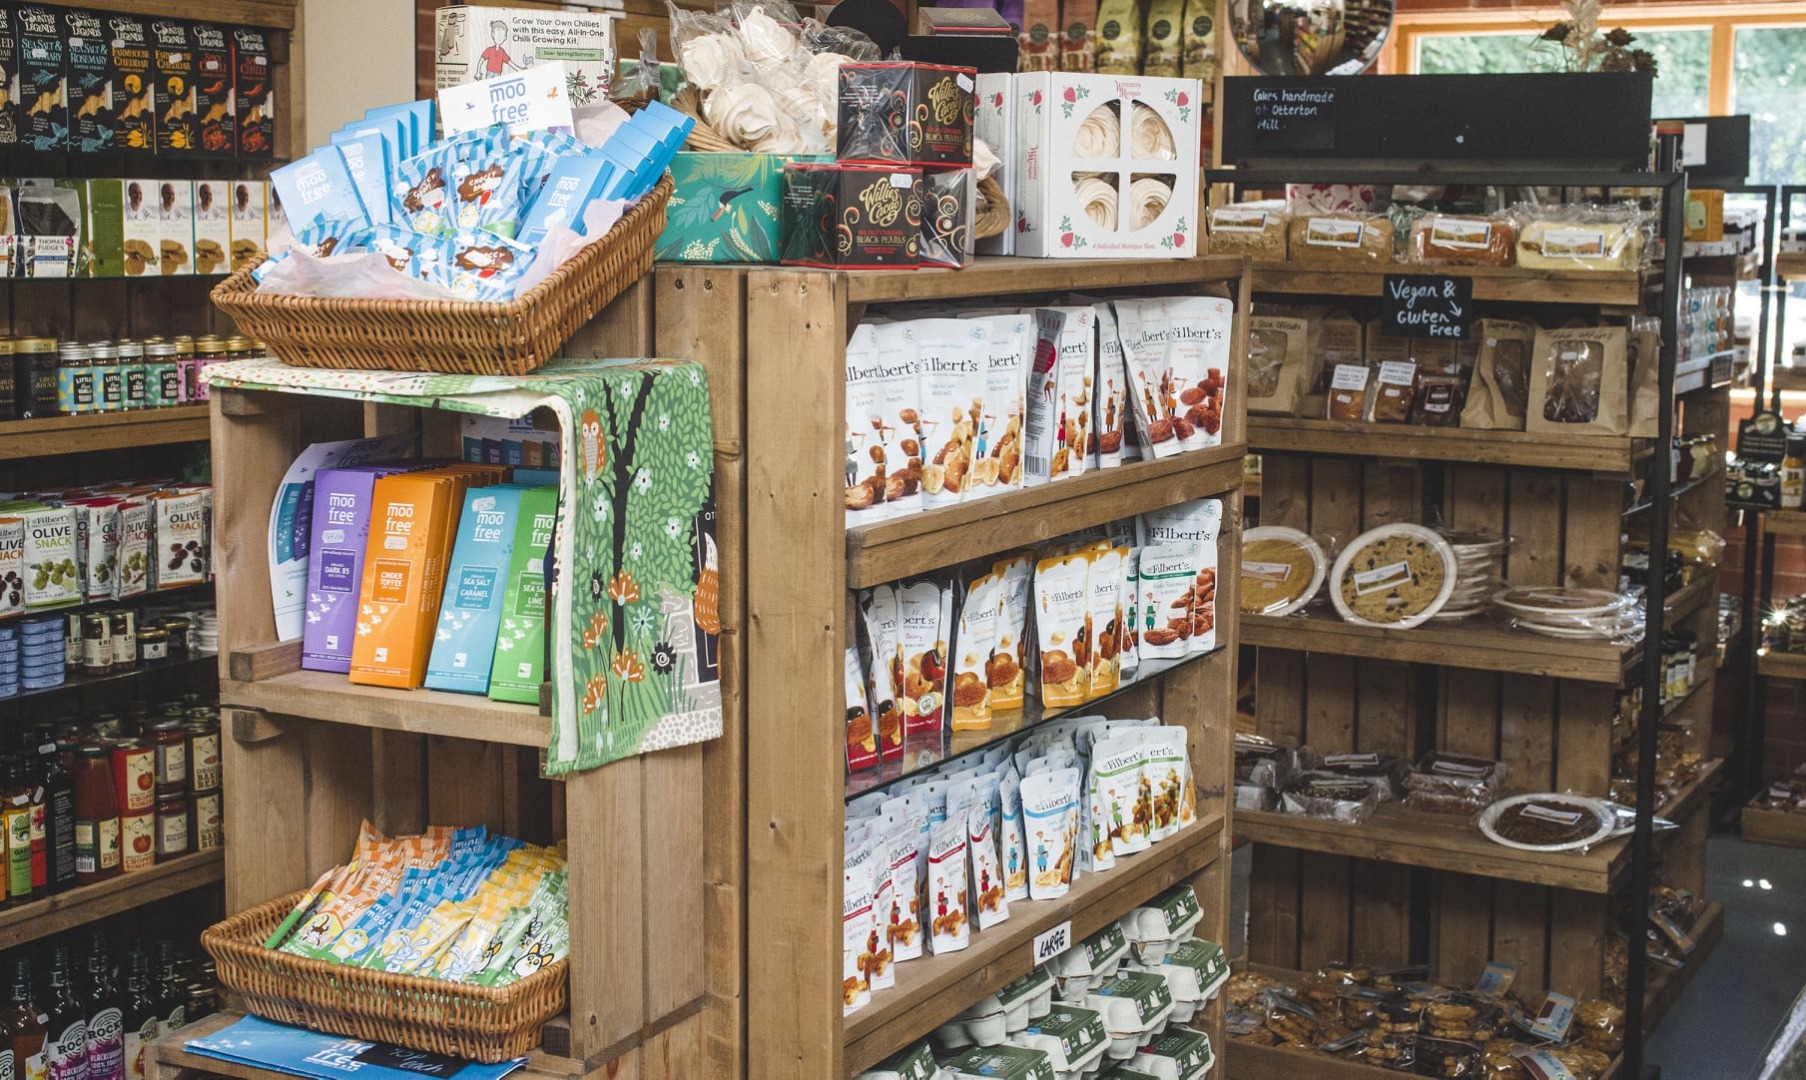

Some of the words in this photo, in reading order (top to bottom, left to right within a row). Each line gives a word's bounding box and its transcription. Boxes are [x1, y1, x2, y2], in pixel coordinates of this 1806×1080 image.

[25, 22, 56, 33] LEGENDS
[512, 17, 533, 25] Grow
[536, 18, 553, 26] Your
[555, 19, 572, 27] Own
[574, 20, 600, 28] Chillies
[72, 26, 102, 37] LEGENDS
[568, 29, 604, 37] All-In-One
[55, 41, 62, 51] &
[532, 36, 565, 45] Growing
[70, 53, 107, 65] ROSEMARY
[113, 57, 149, 68] CHEDDAR
[489, 82, 526, 103] moo
[1282, 90, 1334, 103] handmade
[490, 102, 529, 123] free
[1272, 104, 1318, 116] Otterton
[296, 172, 327, 189] moo
[556, 179, 579, 191] moo
[301, 183, 331, 202] free
[551, 192, 574, 204] free
[869, 200, 901, 227] Cacao
[856, 236, 880, 244] BLACK
[881, 236, 906, 244] PEARLS
[1390, 279, 1438, 308] Vegan
[1443, 280, 1456, 297] &
[1397, 309, 1450, 324] Gluten
[1142, 330, 1169, 343] lbert's
[1429, 325, 1462, 337] Free
[921, 357, 979, 372] ilbert's
[988, 353, 1020, 368] bert'
[879, 361, 920, 378] bert's
[329, 496, 356, 508] moo
[170, 511, 200, 523] OLIVE
[329, 509, 355, 522] free
[387, 506, 414, 517] moo
[386, 519, 412, 532] free
[477, 514, 504, 525] moo
[533, 517, 553, 528] mo
[33, 526, 72, 539] OLIVE
[474, 526, 501, 539] free
[532, 531, 551, 544] fre
[1151, 527, 1211, 541] Filbert's
[0, 539, 23, 550] LIVE
[35, 537, 72, 549] SNACK
[342, 567, 350, 575] 85
[1152, 562, 1190, 573] Filbert's
[381, 572, 403, 580] CINDER
[380, 579, 403, 587] TOFFEE
[536, 585, 546, 593] SA
[460, 590, 489, 598] CARAMEL
[1054, 590, 1084, 602] Filbert's
[1150, 747, 1174, 757] ert's
[1107, 751, 1143, 770] Filbert's
[197, 773, 216, 782] BAK
[197, 780, 216, 789] BEA
[455, 838, 479, 848] mini
[411, 858, 438, 867] mini
[373, 875, 397, 887] moos
[1039, 929, 1065, 958] LARGE
[399, 1061, 444, 1073] each
